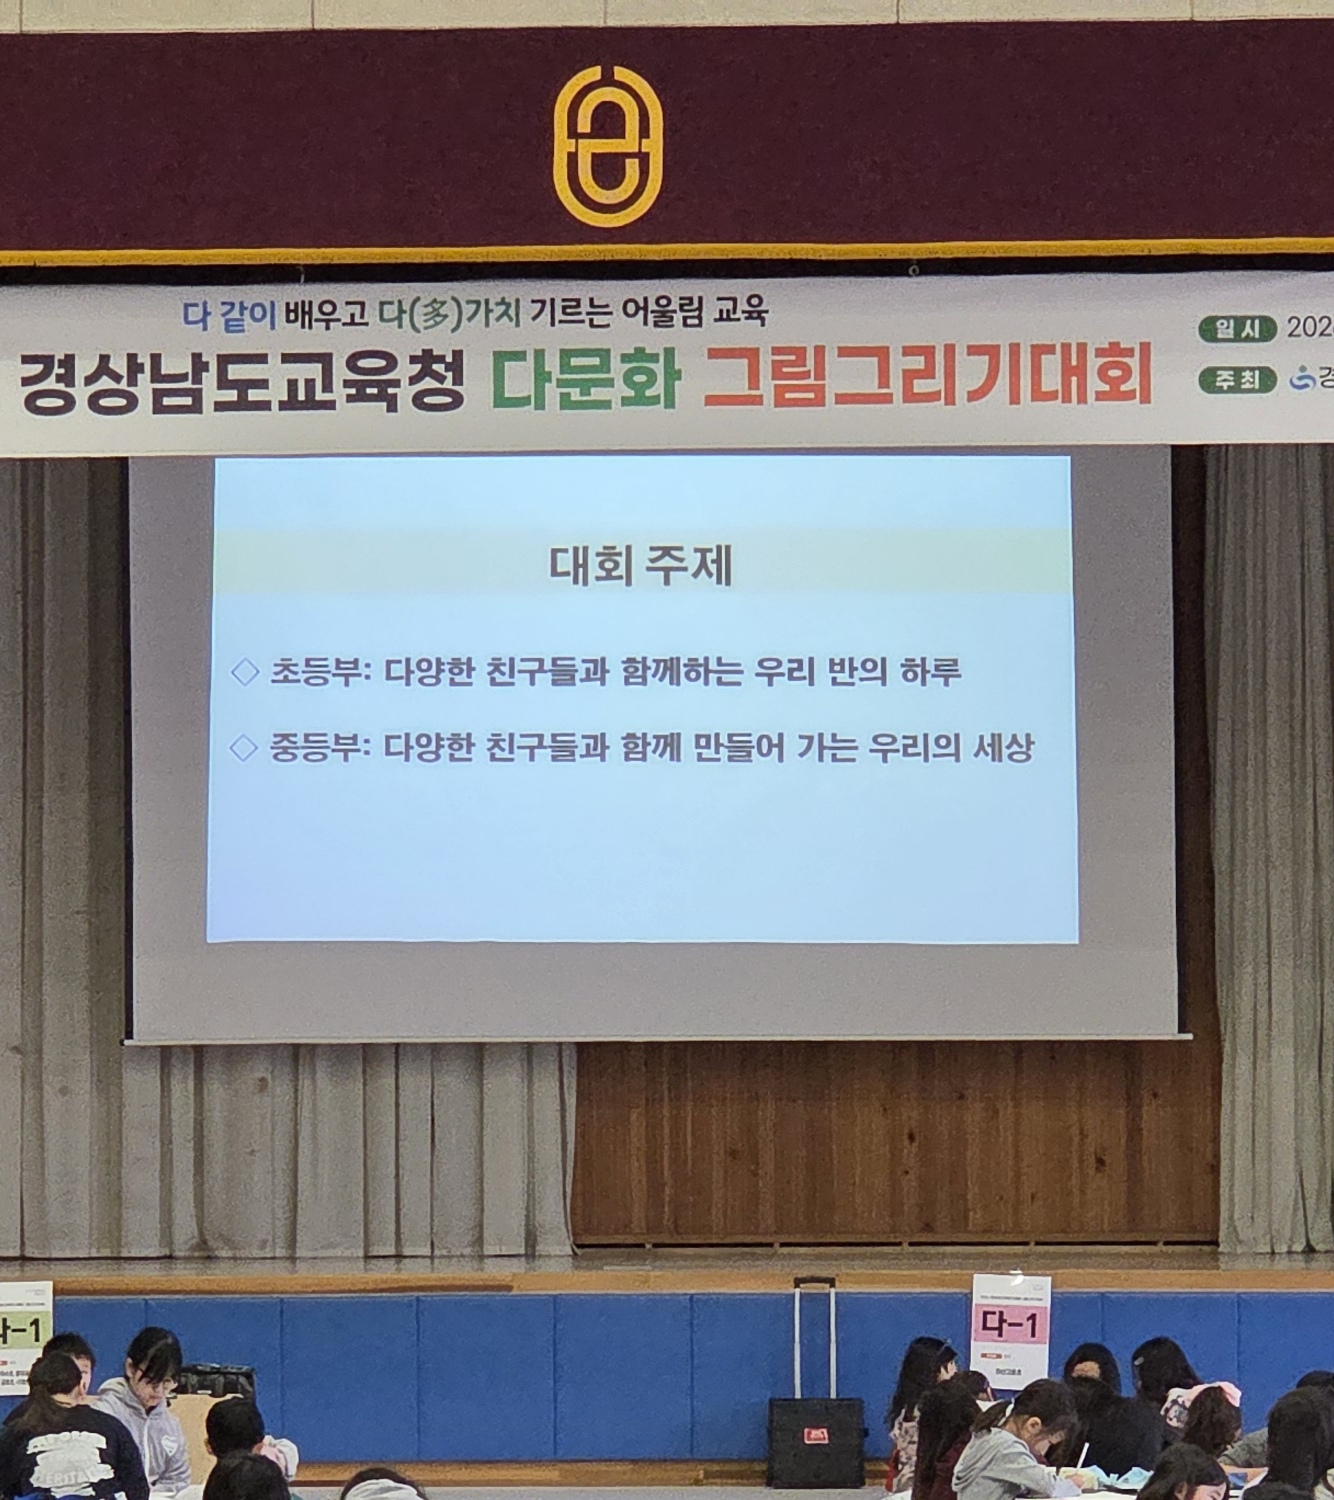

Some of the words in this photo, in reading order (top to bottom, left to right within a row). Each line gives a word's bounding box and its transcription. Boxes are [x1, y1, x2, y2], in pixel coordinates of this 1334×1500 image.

[182, 300, 212, 332] 다
[221, 300, 276, 333] 같이
[285, 299, 370, 331] 배우고
[378, 296, 521, 333] 다(多)가치
[530, 297, 614, 329] 기르는
[622, 295, 704, 329] 어울림
[713, 294, 770, 328] 교육
[20, 349, 465, 417] 경상남도교육청
[492, 346, 682, 411] 다문화
[704, 341, 1151, 409] 그림그리기대회
[551, 544, 633, 587] 대회
[645, 544, 732, 587] 주제
[270, 657, 372, 687] 초등부:
[385, 656, 477, 687] 다양한
[486, 656, 611, 687] 친구들과
[620, 656, 745, 687] 함께하는
[754, 656, 815, 687] 우리
[828, 656, 887, 687] 반의
[900, 656, 963, 688] 하루
[269, 733, 371, 763] 중등부:
[384, 732, 476, 763] 다양한
[486, 732, 611, 763] 친구들과
[620, 732, 682, 763] 함께
[694, 732, 784, 763] 만들어
[797, 732, 859, 763] 가는
[869, 732, 961, 763] 우리의
[973, 732, 1036, 764] 세상
[981, 1310, 1038, 1338] 다-1
